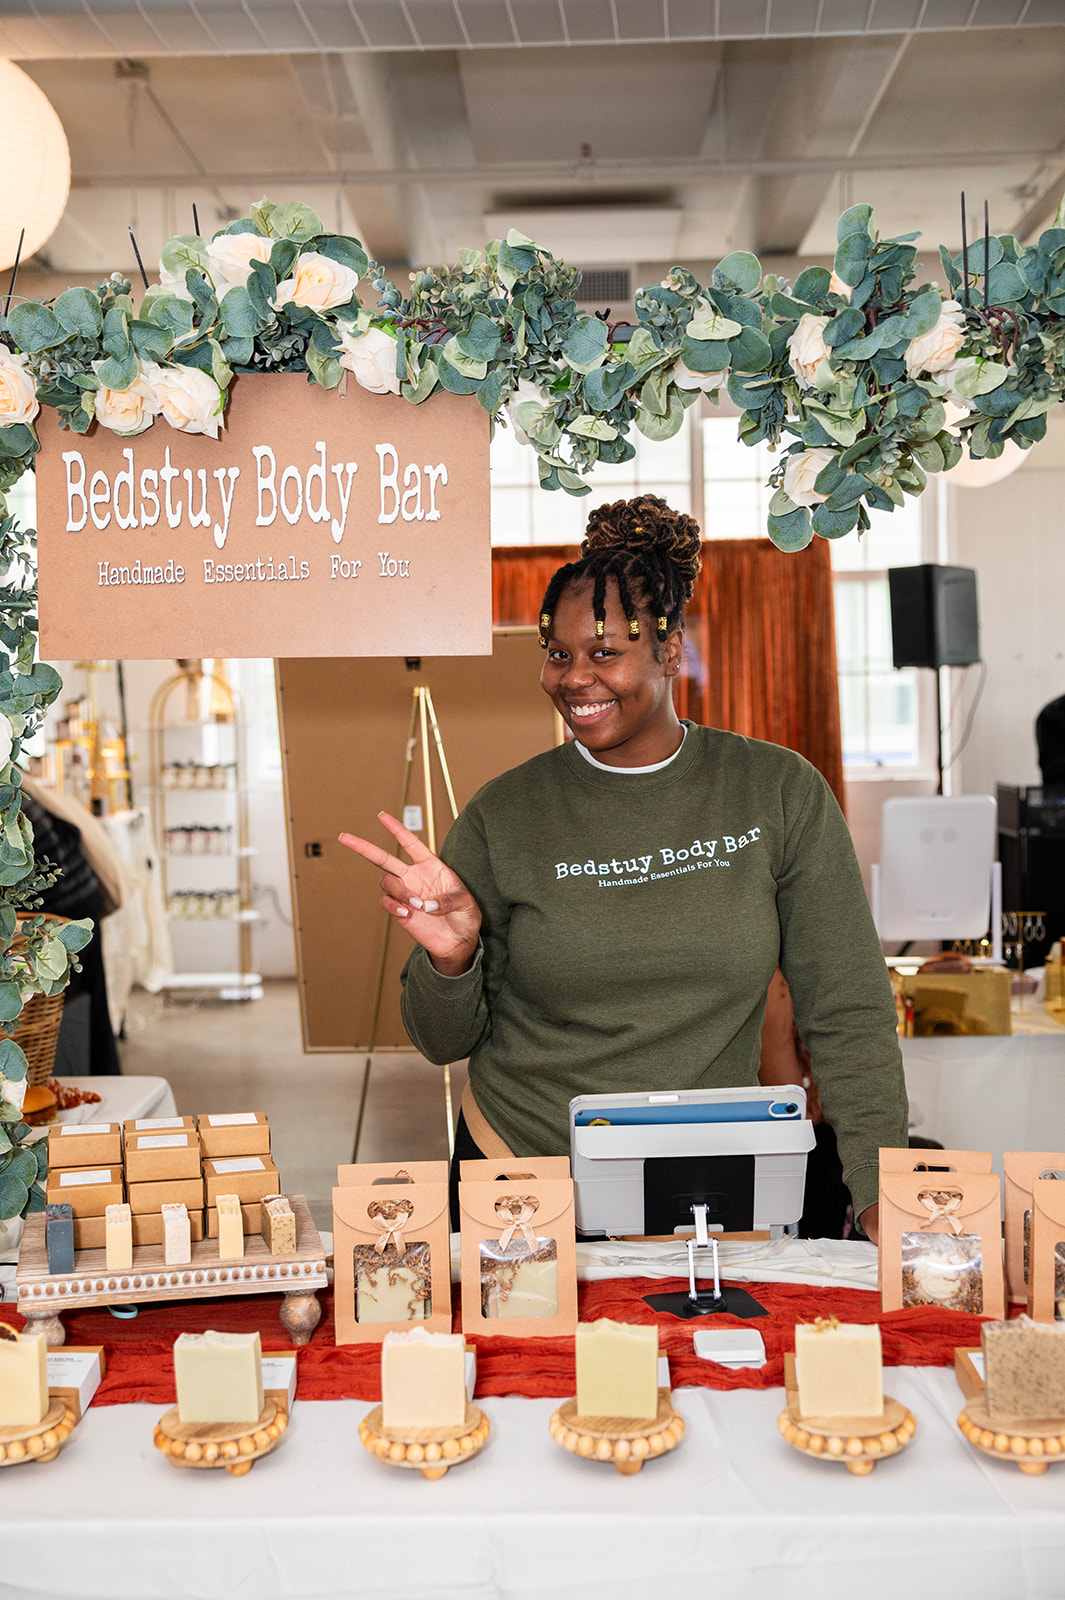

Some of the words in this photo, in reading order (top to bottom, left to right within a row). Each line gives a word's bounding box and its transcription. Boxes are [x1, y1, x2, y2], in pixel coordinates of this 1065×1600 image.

[62, 445, 240, 549] Bedstuy
[252, 440, 358, 544] Body
[375, 442, 449, 525] Bar
[98, 560, 186, 586] Handmade
[203, 555, 310, 584] Essentials
[330, 554, 362, 579] For
[378, 552, 410, 579] You
[554, 854, 653, 880] Bedstuy
[659, 839, 718, 866] Body
[722, 827, 761, 853] Bar
[598, 875, 649, 888] Handmade
[650, 862, 696, 881] Essentials
[697, 861, 713, 870] For
[713, 858, 731, 867] You
